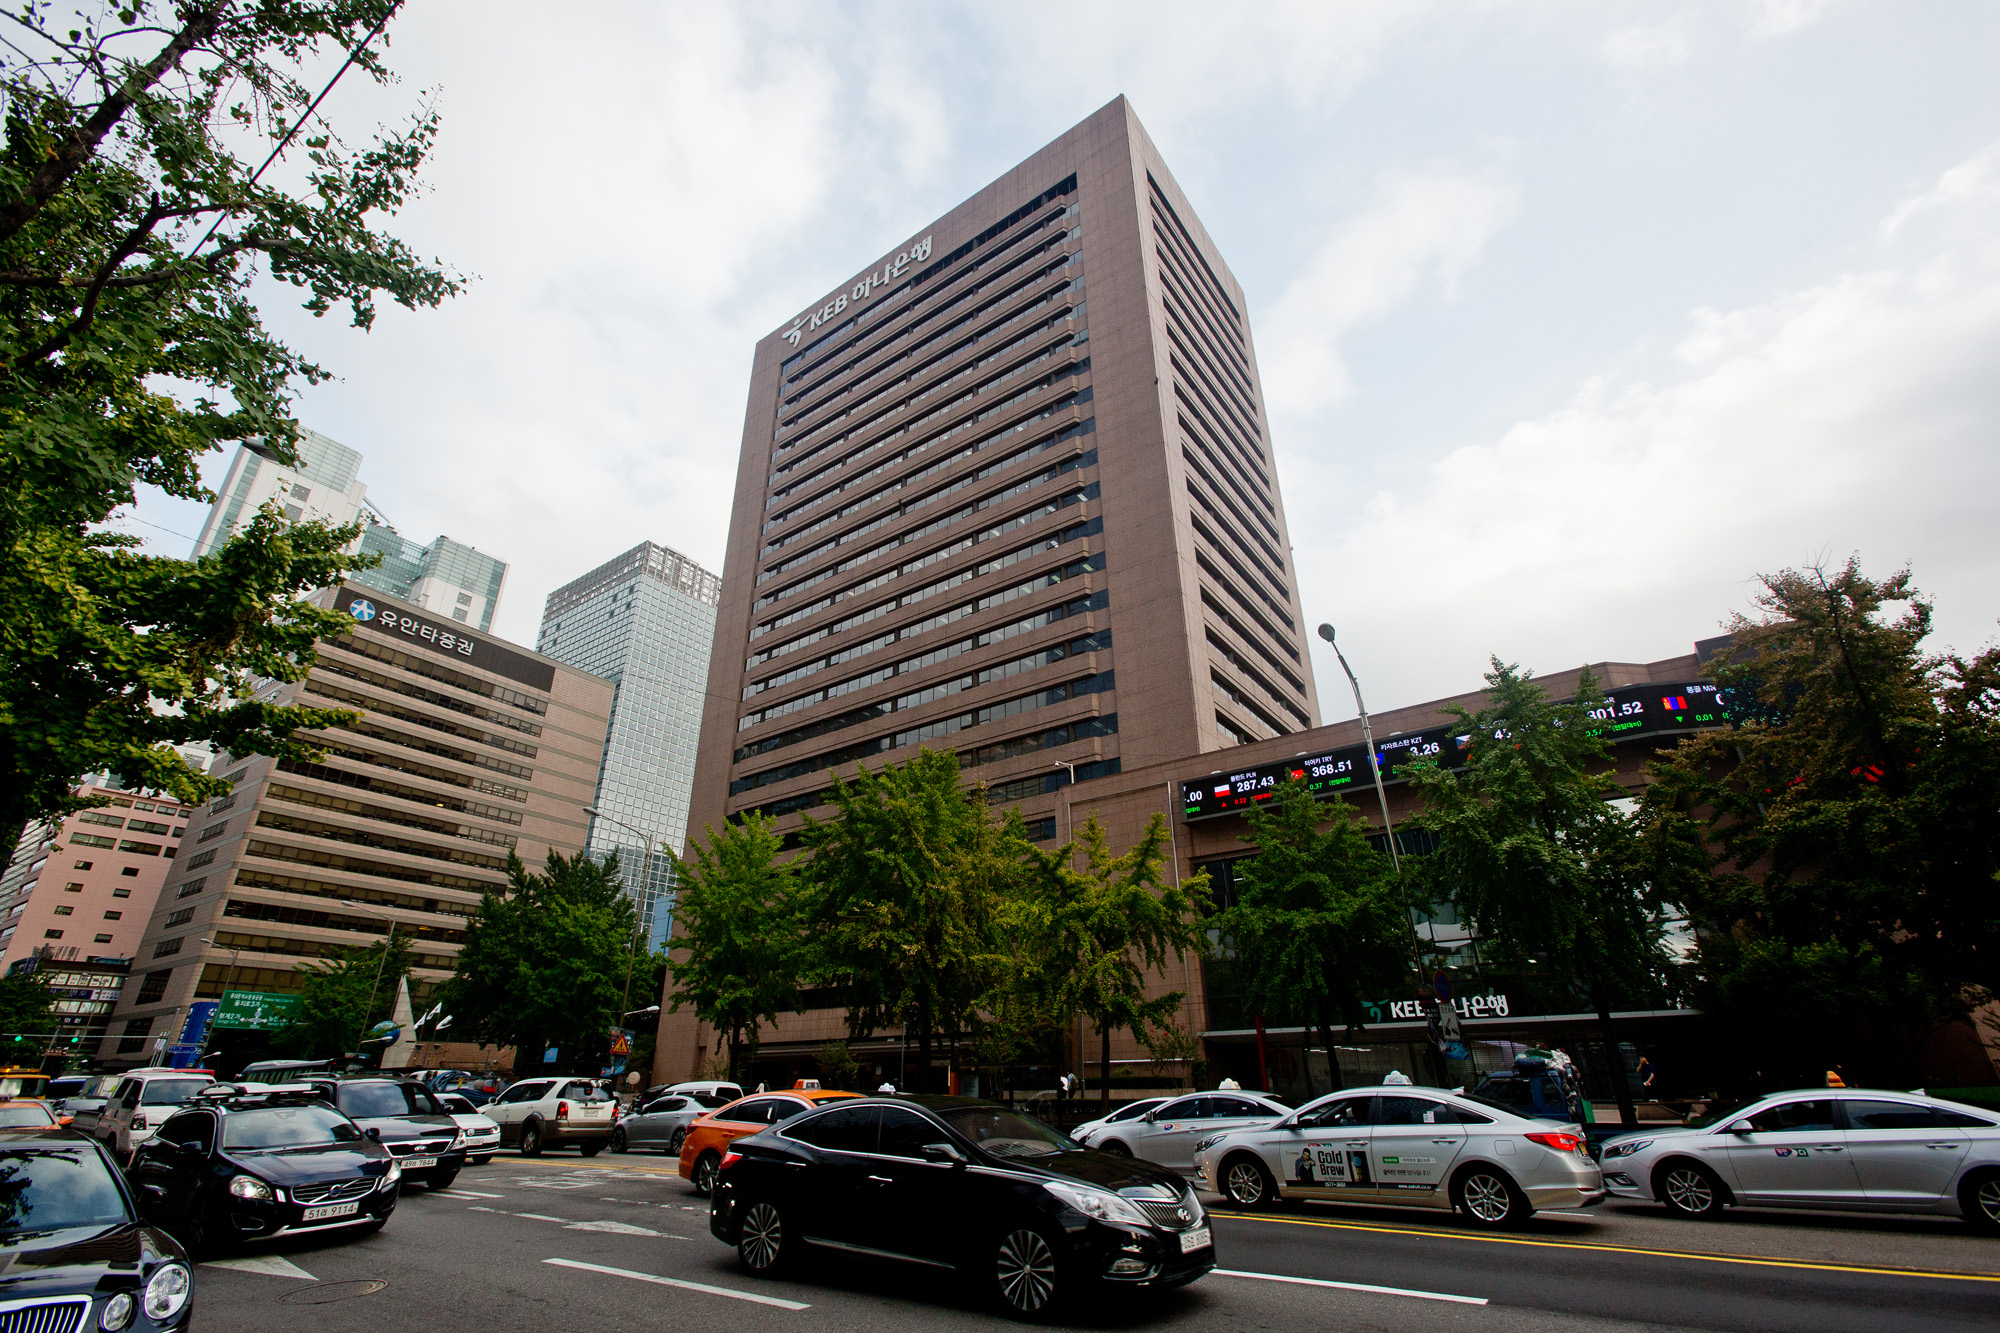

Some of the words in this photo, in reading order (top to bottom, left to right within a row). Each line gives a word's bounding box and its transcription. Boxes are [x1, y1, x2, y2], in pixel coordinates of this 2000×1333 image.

[809, 294, 848, 331] KEB
[852, 235, 932, 301] 하나은행
[378, 610, 474, 656] 유안타증권
[1702, 684, 1717, 692] MN
[1587, 701, 1644, 720] 301.52
[1695, 713, 1714, 721] 0.01
[1410, 736, 1423, 745] KZT
[1410, 742, 1440, 756] 3.26
[1321, 755, 1333, 763] TRY
[1246, 771, 1257, 779] PLN
[1312, 760, 1352, 777] 368.51
[1237, 776, 1275, 793] 287.43
[1309, 782, 1323, 790] 0.37
[1184, 790, 1203, 803] .00
[1435, 994, 1509, 1018] 나은행
[1317, 1150, 1343, 1164] Cold
[1319, 1163, 1345, 1176] Brew
[331, 1204, 354, 1216] 9114
